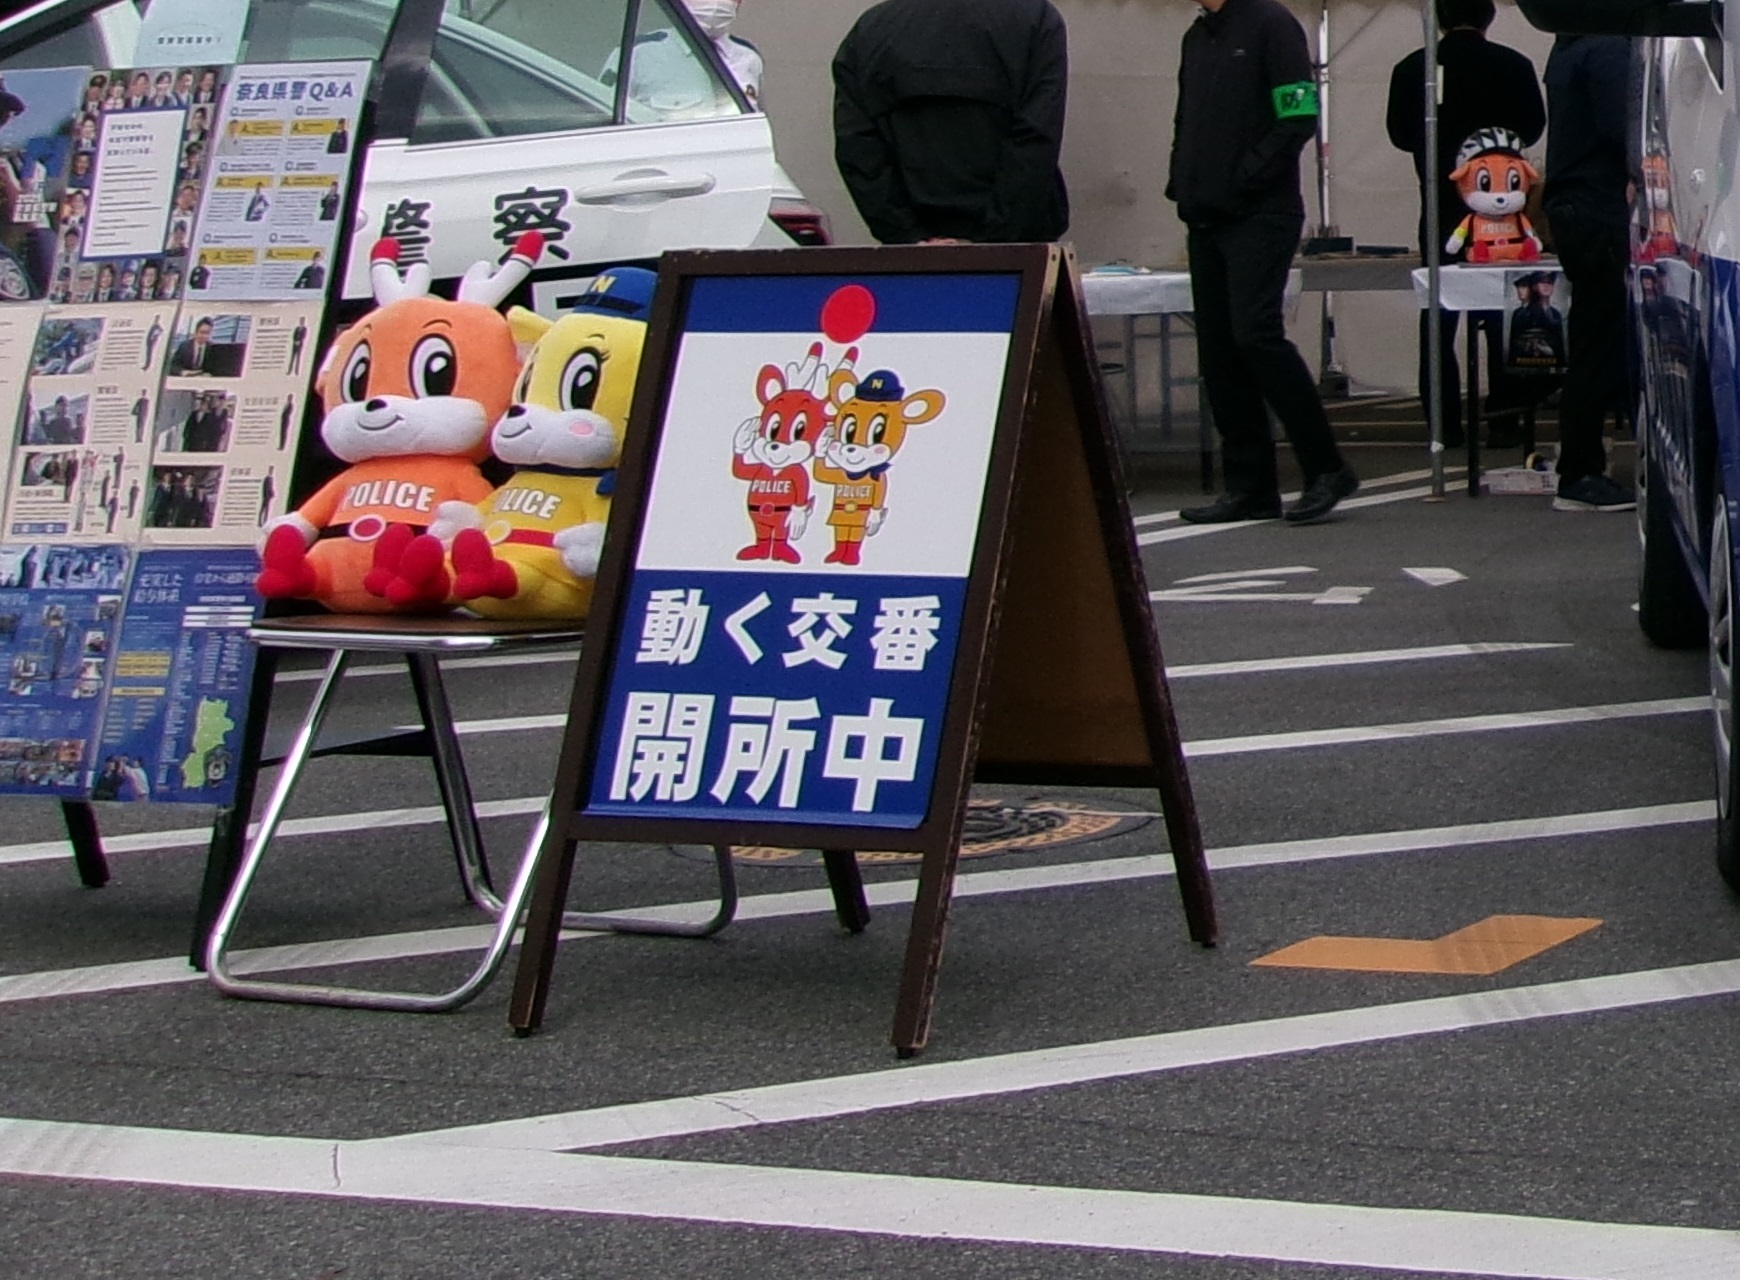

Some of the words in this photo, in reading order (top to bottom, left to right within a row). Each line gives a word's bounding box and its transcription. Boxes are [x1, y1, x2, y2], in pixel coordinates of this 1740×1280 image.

[342, 480, 436, 513] POLICE
[751, 479, 793, 494] POLICE
[836, 484, 874, 498] POLICE
[635, 588, 942, 671] 動く交番
[608, 692, 926, 813] 開所中
